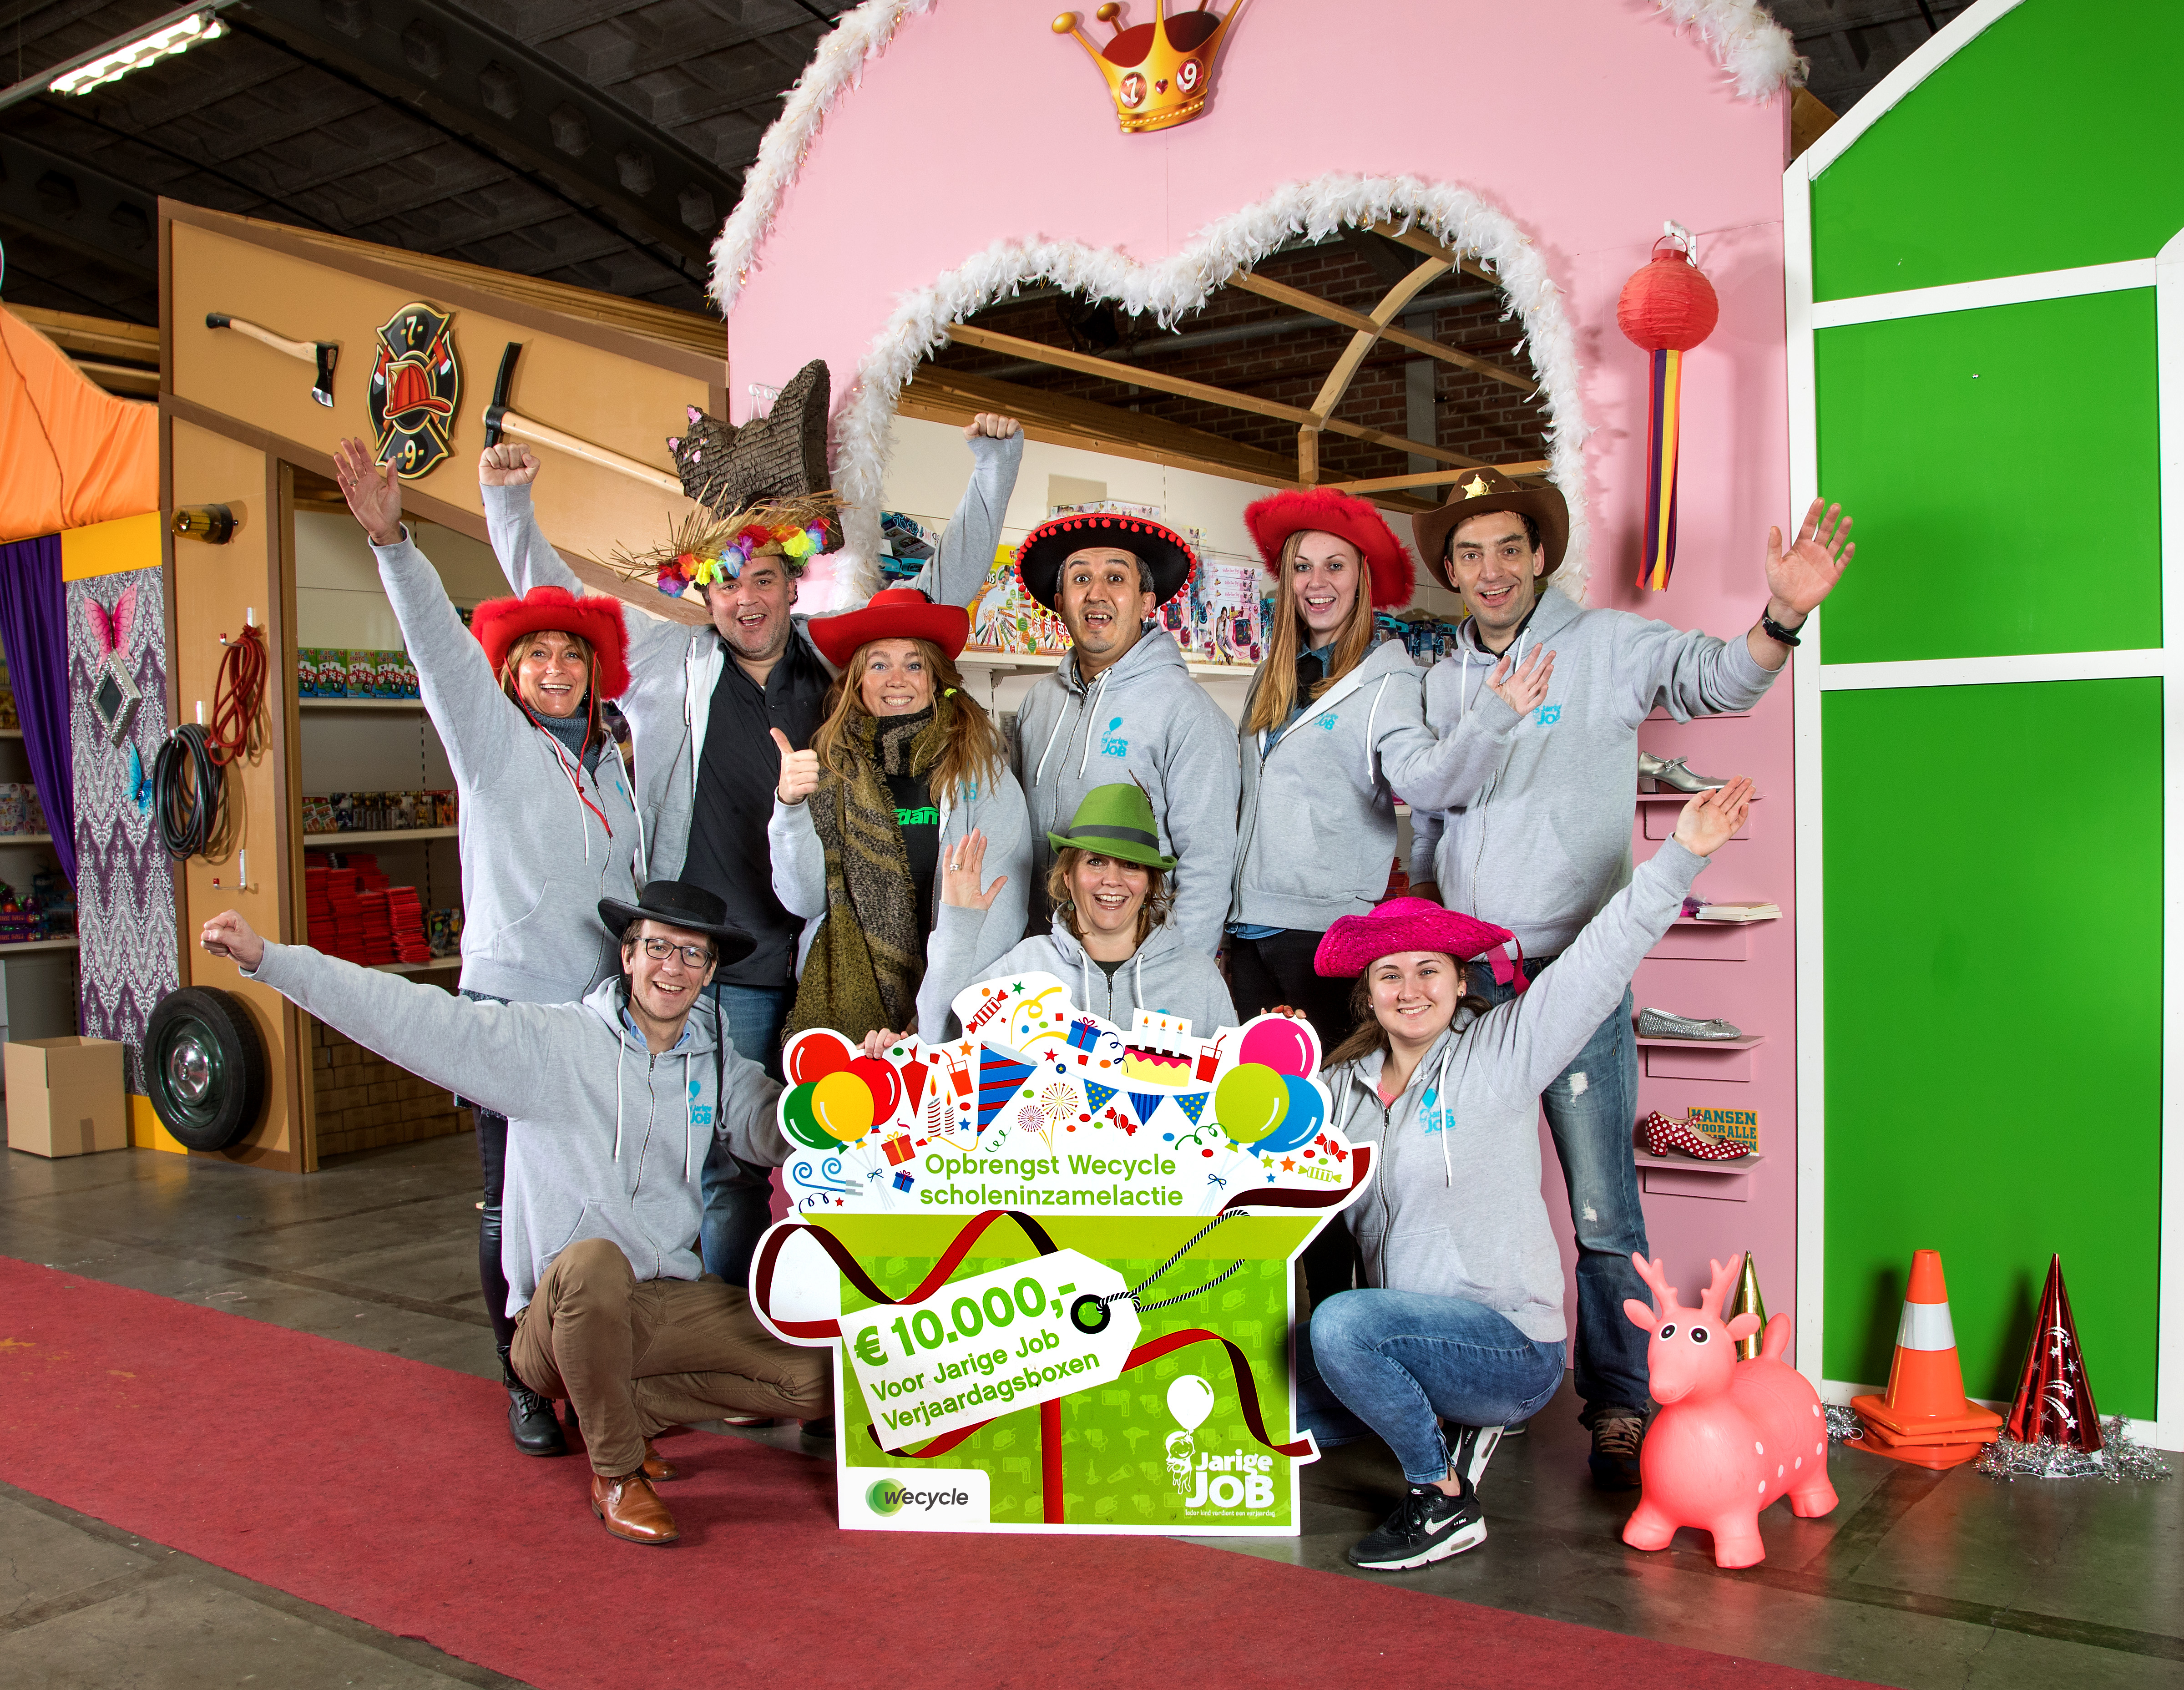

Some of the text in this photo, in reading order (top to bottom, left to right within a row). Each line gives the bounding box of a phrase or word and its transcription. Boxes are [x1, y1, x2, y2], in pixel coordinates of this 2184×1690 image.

[1126, 63, 1197, 103] 7 9
[406, 316, 418, 345] 7
[404, 440, 416, 470] 9
[1102, 741, 1127, 757] JOB
[690, 1111, 711, 1124] JOB
[1727, 1126, 1756, 1139] ALLE
[925, 1153, 1176, 1181] Opbrengst Wecycle
[920, 1184, 1183, 1206] scholeninzamelactie
[854, 1277, 1077, 1366] € 10.000,-
[870, 1329, 1060, 1402] Voor Jarige Job
[881, 1352, 1100, 1431] Verjaardagsboxen
[1196, 1448, 1273, 1475] Jarige
[1185, 1471, 1274, 1508] JOB
